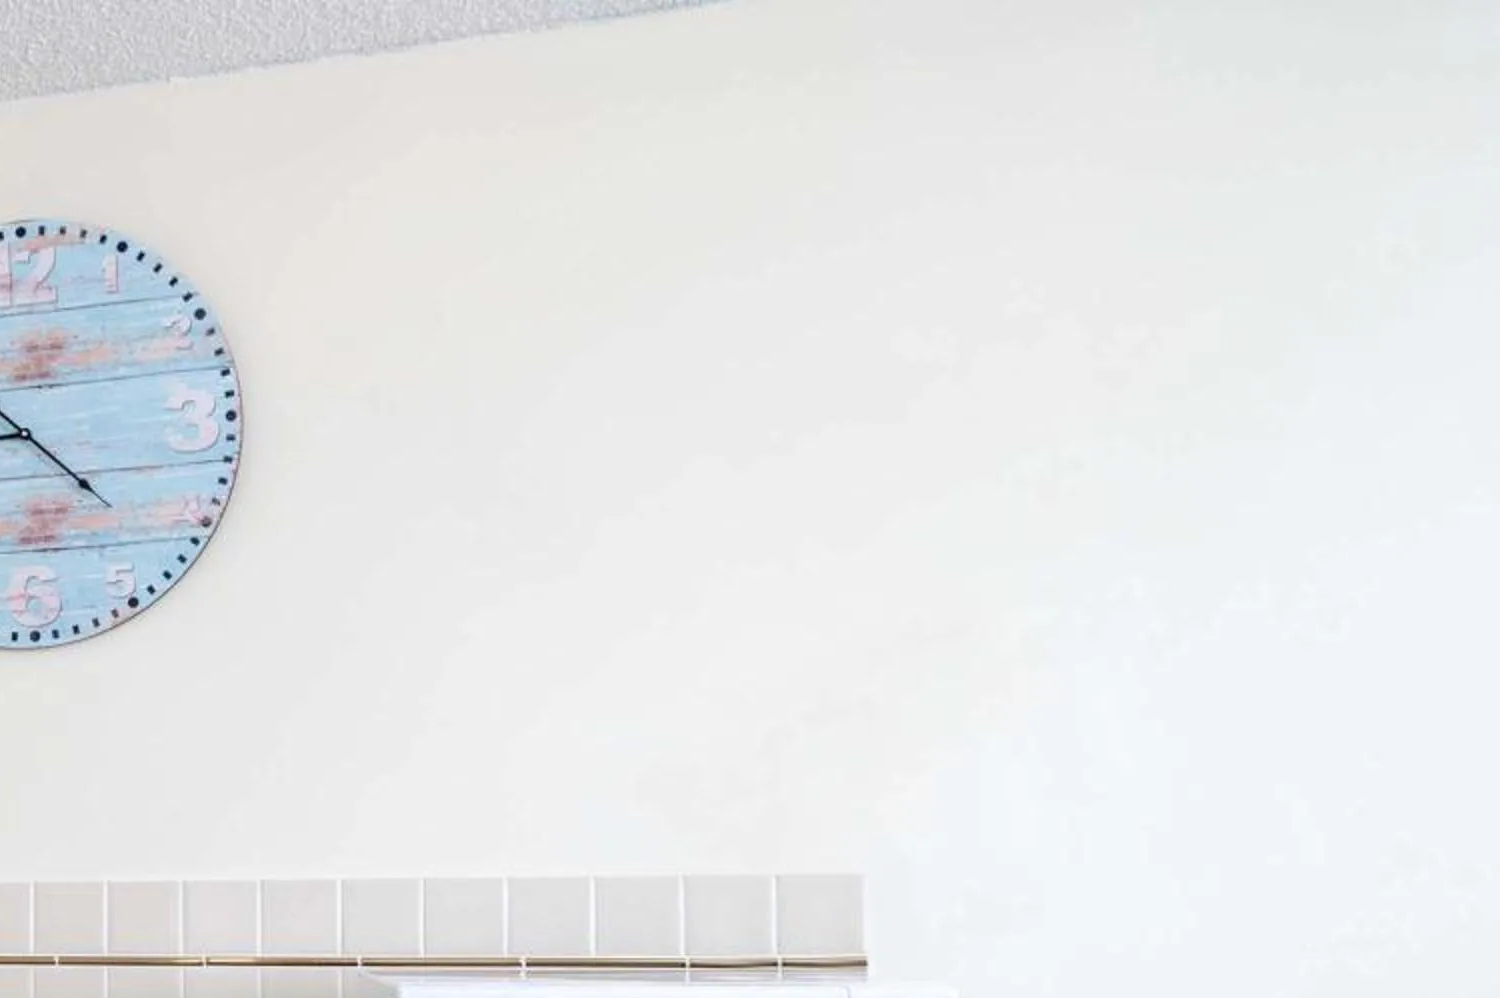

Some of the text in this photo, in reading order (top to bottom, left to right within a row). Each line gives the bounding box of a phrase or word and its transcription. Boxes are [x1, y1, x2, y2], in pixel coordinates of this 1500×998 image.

[102, 253, 119, 294] 1
[164, 386, 220, 453] 3
[9, 565, 63, 628] 6
[105, 563, 136, 598] 5
